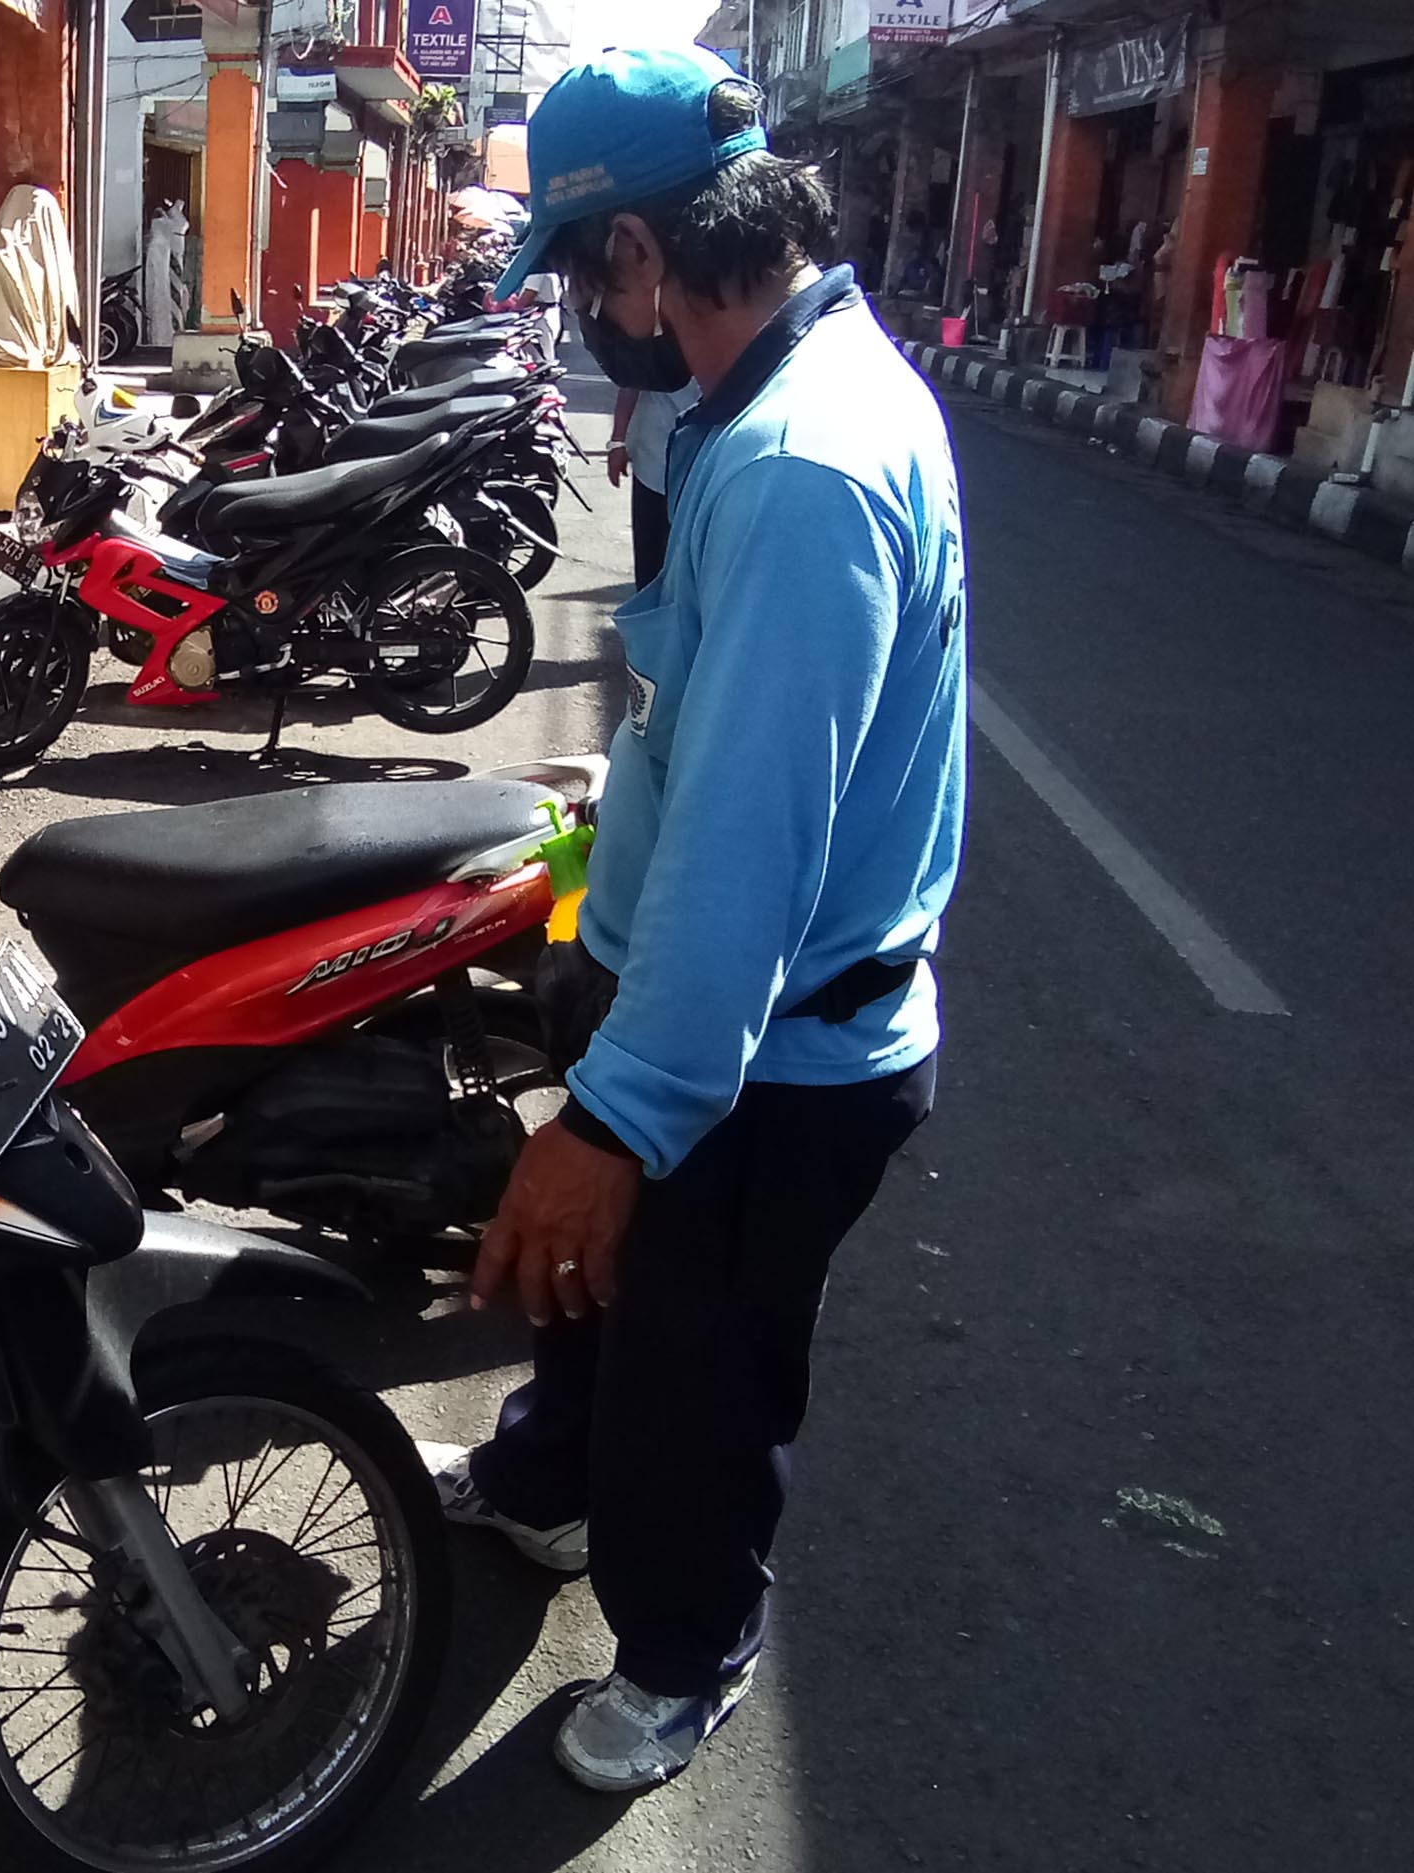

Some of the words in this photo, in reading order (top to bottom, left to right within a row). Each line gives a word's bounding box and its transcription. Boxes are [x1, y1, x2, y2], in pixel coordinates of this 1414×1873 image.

[876, 13, 942, 26] TEXTILE
[412, 33, 468, 47] TEXTILE
[0, 536, 26, 561] 5473
